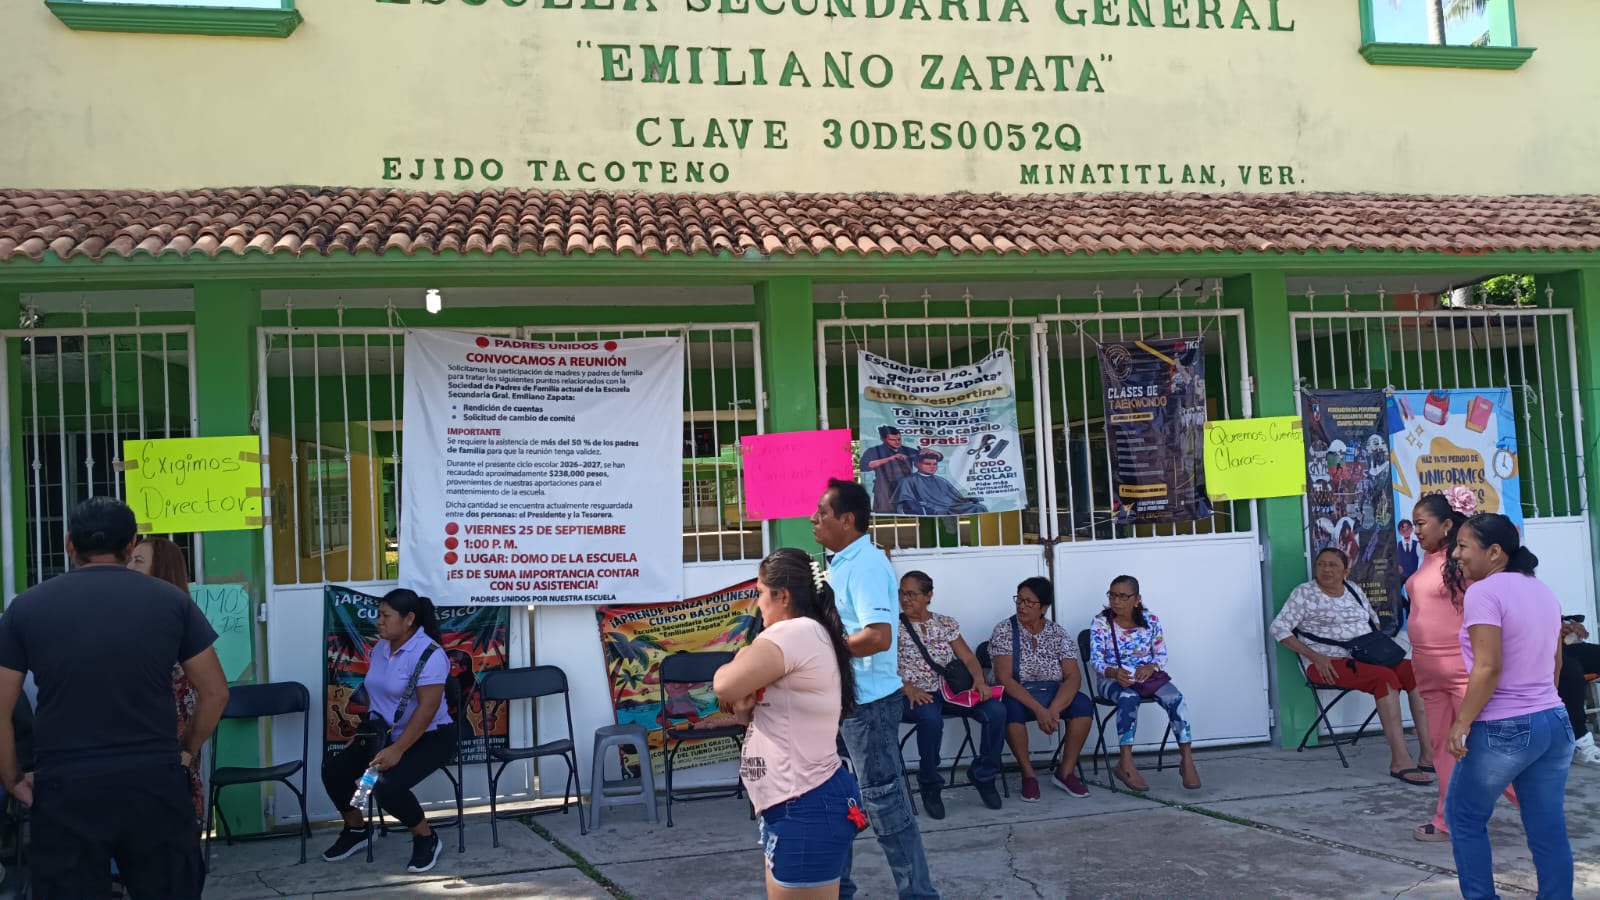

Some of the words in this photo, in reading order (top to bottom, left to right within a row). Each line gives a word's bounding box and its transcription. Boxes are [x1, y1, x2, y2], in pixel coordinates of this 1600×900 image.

[1055, 0, 1294, 31] GENERAL
[636, 117, 788, 149] CLAVE
[823, 119, 1081, 152] 30DES0052Q
[381, 157, 504, 182] EJIDO
[527, 160, 730, 183] TACOTENO
[1020, 164, 1226, 187] MINATITLAN,
[1238, 165, 1305, 185] VER.
[495, 340, 545, 349] PADRES
[548, 342, 598, 350] UNIDOS
[466, 353, 555, 366] CONVOCAMOS
[558, 357, 567, 366] A
[570, 355, 627, 366] REUNIÓN
[886, 372, 946, 384] general
[448, 382, 483, 390] Sociedad
[495, 383, 521, 391] Padres
[1107, 386, 1143, 399] CLASES
[1146, 385, 1158, 396] DE
[448, 391, 491, 399] Secundaria
[546, 394, 576, 402] Zapata:
[513, 404, 543, 412] cuentas
[1109, 396, 1167, 409] TAEKWONDO
[463, 413, 496, 421] Solicitud
[549, 414, 575, 422] comité
[892, 407, 911, 416] Te
[915, 408, 959, 418] invita
[447, 428, 501, 436] IMPORTANTE
[937, 427, 953, 435] de
[457, 437, 487, 446] requiere
[614, 439, 639, 448] padres
[919, 435, 968, 447] gratis
[142, 441, 241, 486] Exigimos
[975, 459, 1006, 467] TODO
[485, 470, 548, 478] aproximadamente
[980, 466, 1012, 474] CICLO
[1419, 467, 1485, 486] UNIFORMES
[139, 487, 255, 519] Director.
[590, 502, 633, 510] resguardada
[464, 525, 516, 535] VIERNES
[519, 525, 533, 535] 25
[536, 525, 552, 535] DE
[555, 525, 626, 535] SEPTIEMBRE
[464, 539, 489, 549] 1:00
[492, 539, 502, 549] P.
[504, 539, 518, 549] M.
[464, 554, 508, 563] LUGAR:
[511, 553, 549, 563] DOMO
[551, 553, 566, 563] DE
[569, 553, 584, 563] LA
[586, 553, 637, 563] ESCUELA
[447, 570, 463, 580] ¡ES
[466, 570, 481, 579] DE
[484, 569, 517, 578] SUMA
[519, 569, 595, 578] IMPORTANCIA
[597, 569, 639, 578] CONTAR
[490, 581, 513, 590] CON
[516, 581, 531, 590] SU
[533, 580, 598, 590] ASISTENCIA!
[609, 606, 664, 629] ¡APRENDE
[667, 600, 704, 613] DANZA
[706, 590, 760, 605] POLINESIA
[649, 612, 687, 626] CURSO
[690, 603, 730, 619] BÁSICO
[633, 627, 661, 635] Escuela
[662, 621, 702, 632] Secundaria
